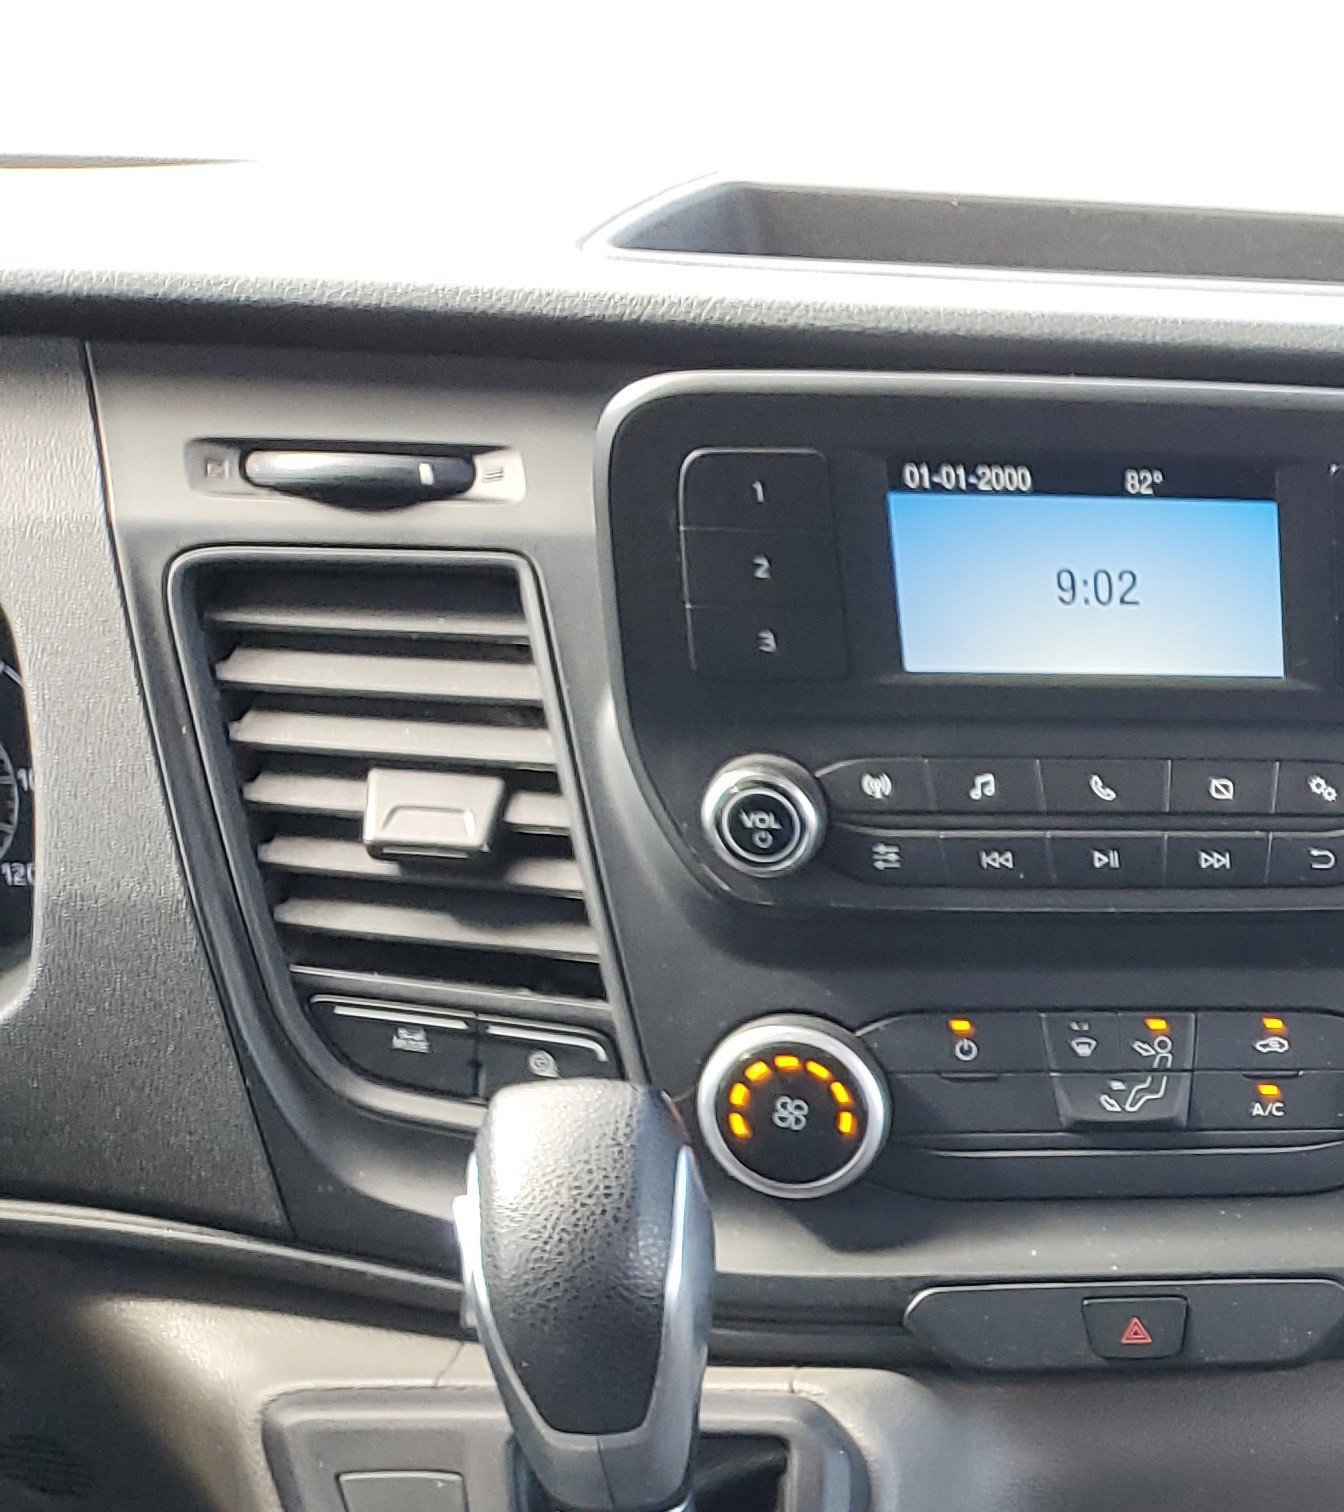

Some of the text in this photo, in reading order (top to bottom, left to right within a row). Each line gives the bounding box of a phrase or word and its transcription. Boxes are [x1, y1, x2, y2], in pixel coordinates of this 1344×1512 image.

[904, 463, 1033, 492] 01-01-2000
[751, 480, 766, 503] 1
[752, 554, 771, 579] 2
[1056, 568, 1141, 606] 9:02
[757, 628, 778, 654] 3
[739, 809, 782, 831] VOL
[1252, 1102, 1285, 1117] A/C
